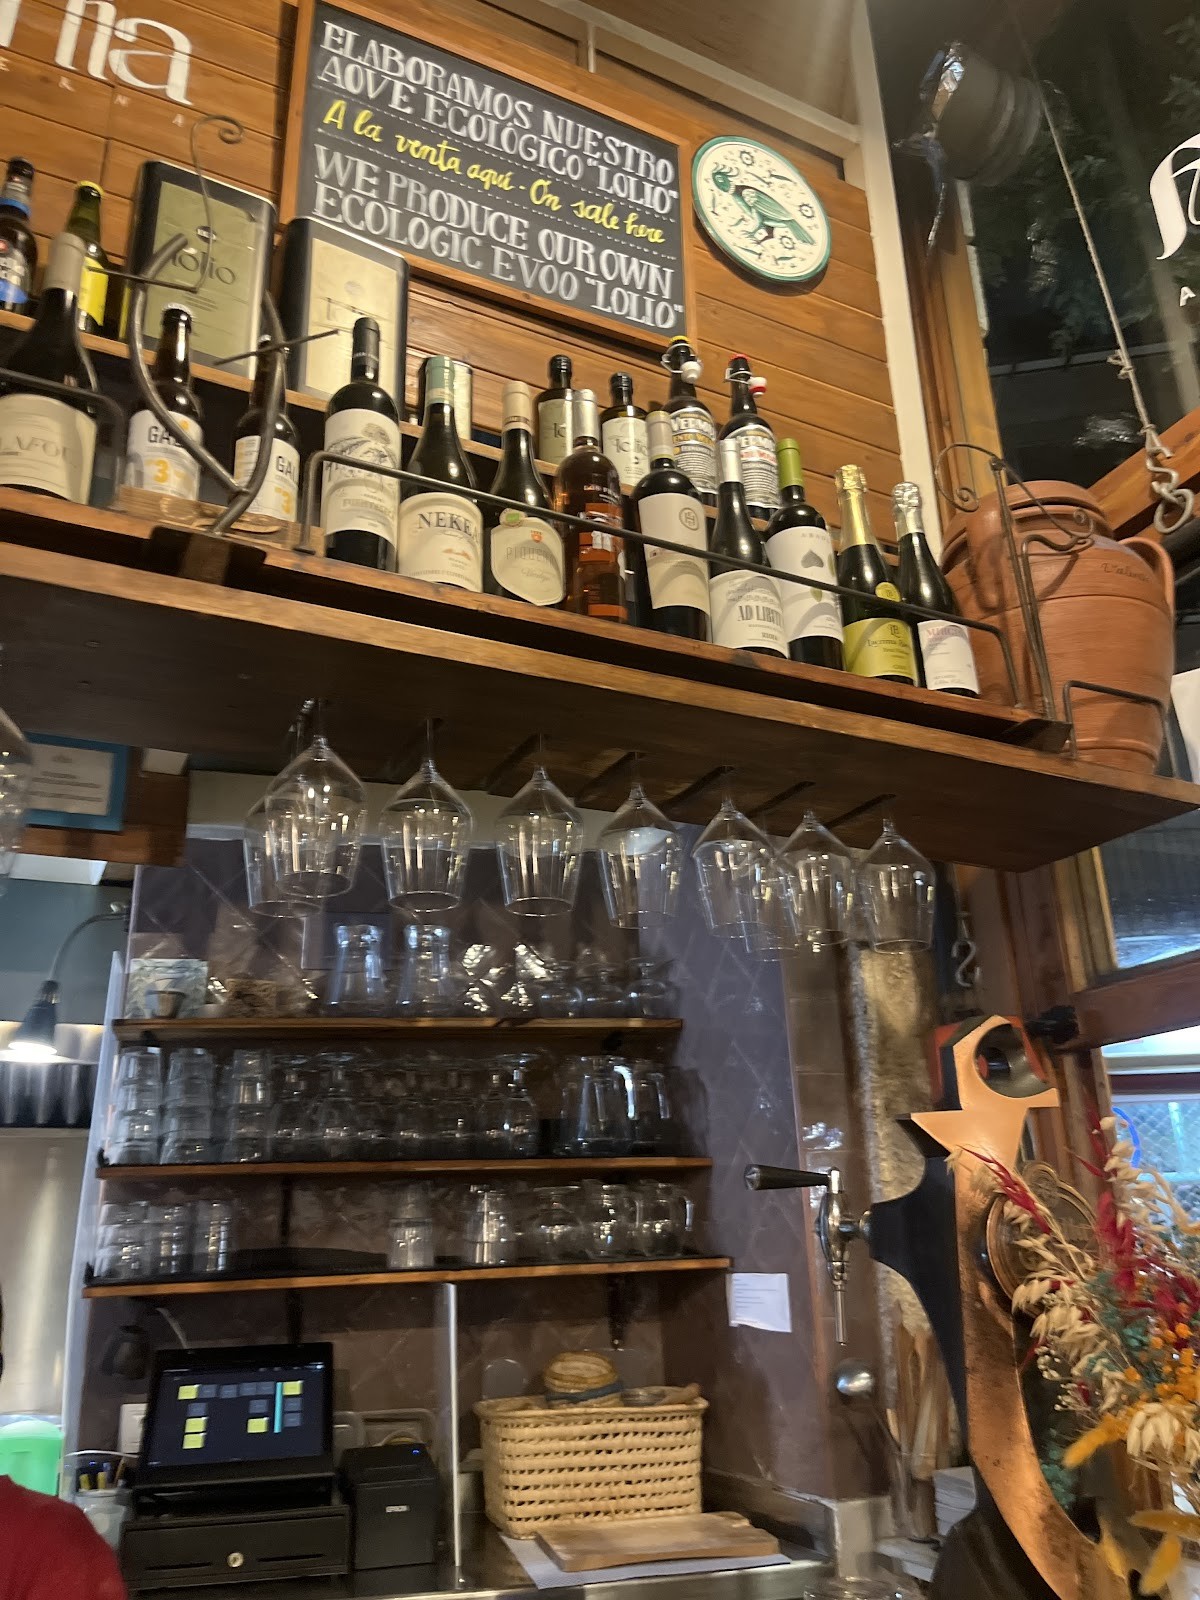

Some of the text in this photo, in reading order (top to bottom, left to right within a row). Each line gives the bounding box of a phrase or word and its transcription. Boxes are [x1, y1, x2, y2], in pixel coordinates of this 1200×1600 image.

[317, 55, 416, 114] AOVE
[422, 92, 584, 180] ECOLÓGICO
[320, 21, 675, 184] ELABORAMOS NUESTRO
[323, 99, 345, 130] A
[353, 110, 382, 142] la
[395, 133, 461, 174] venta
[529, 178, 562, 211] On
[572, 200, 620, 231] sale
[624, 213, 666, 243] here
[312, 181, 484, 270] ECOLOGIC
[490, 245, 580, 300] EVOO
[314, 143, 675, 298] WE PRODUCE OUR OWN
